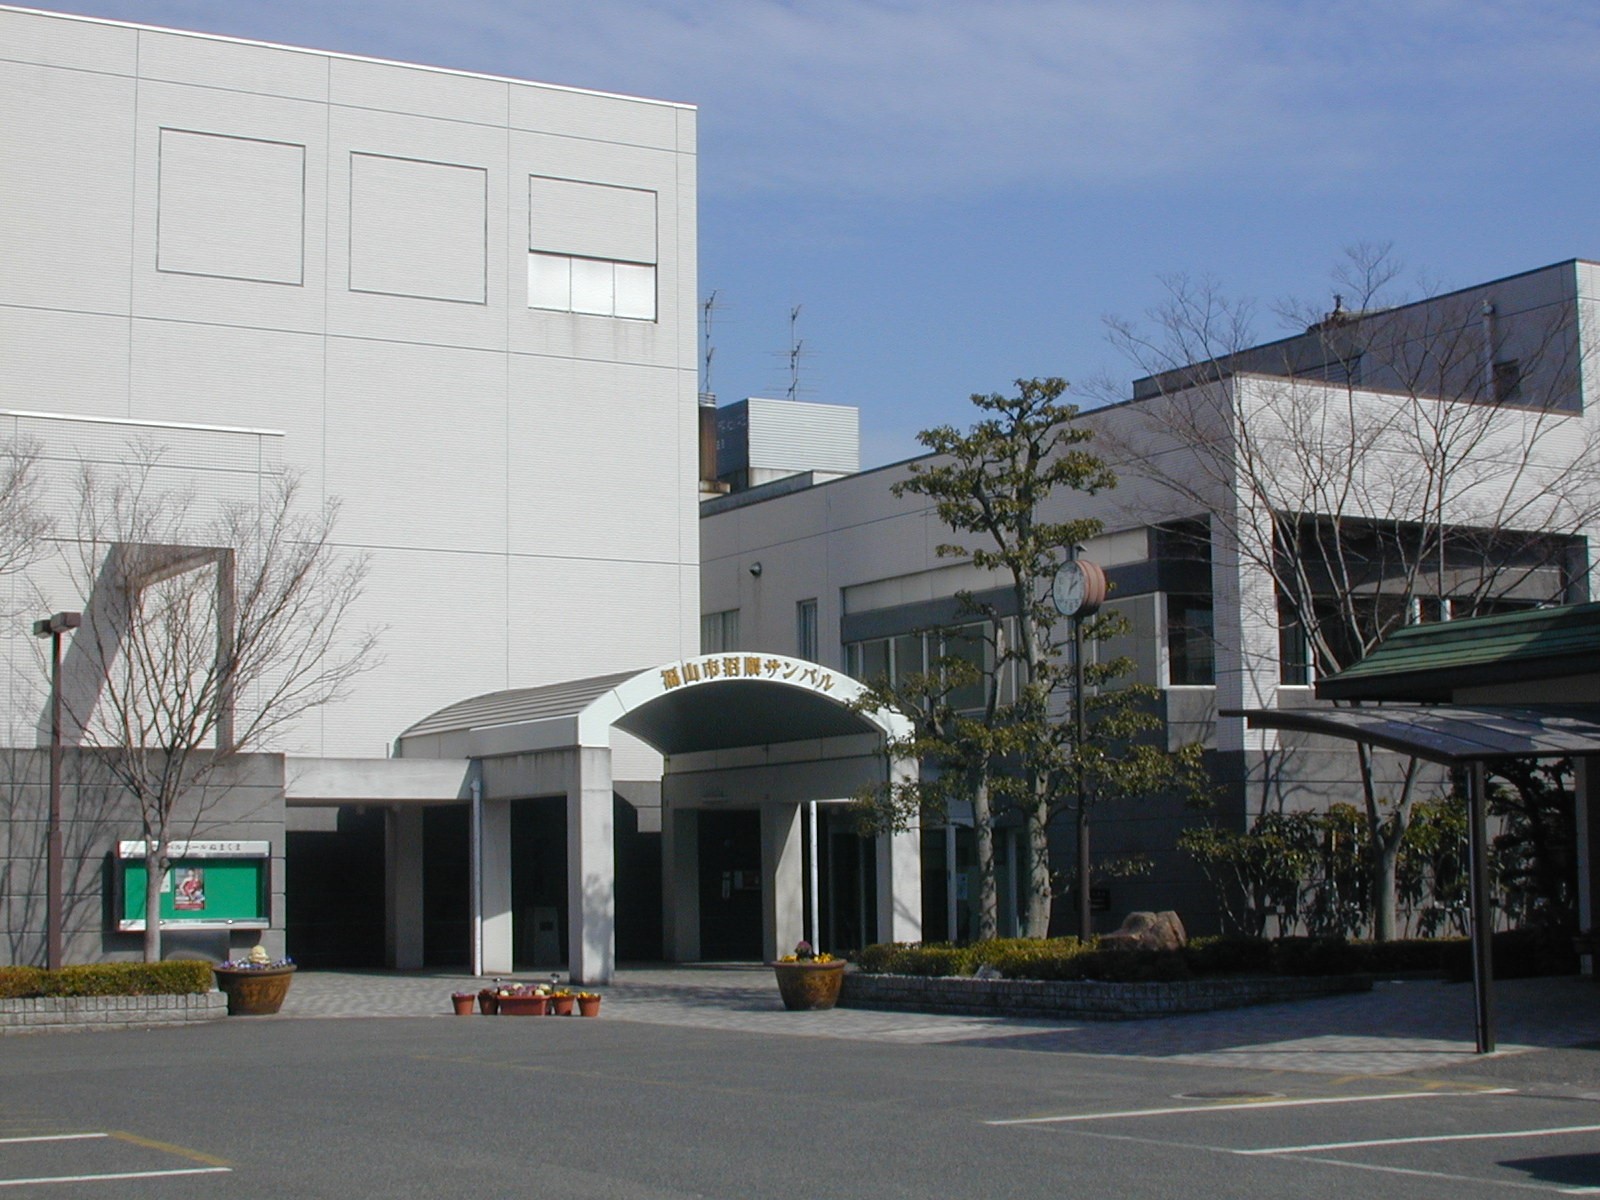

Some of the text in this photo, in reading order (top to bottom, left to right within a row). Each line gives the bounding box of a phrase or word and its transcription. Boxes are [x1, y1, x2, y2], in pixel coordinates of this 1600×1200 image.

[660, 656, 836, 691] 福山市沼隈サンパル
